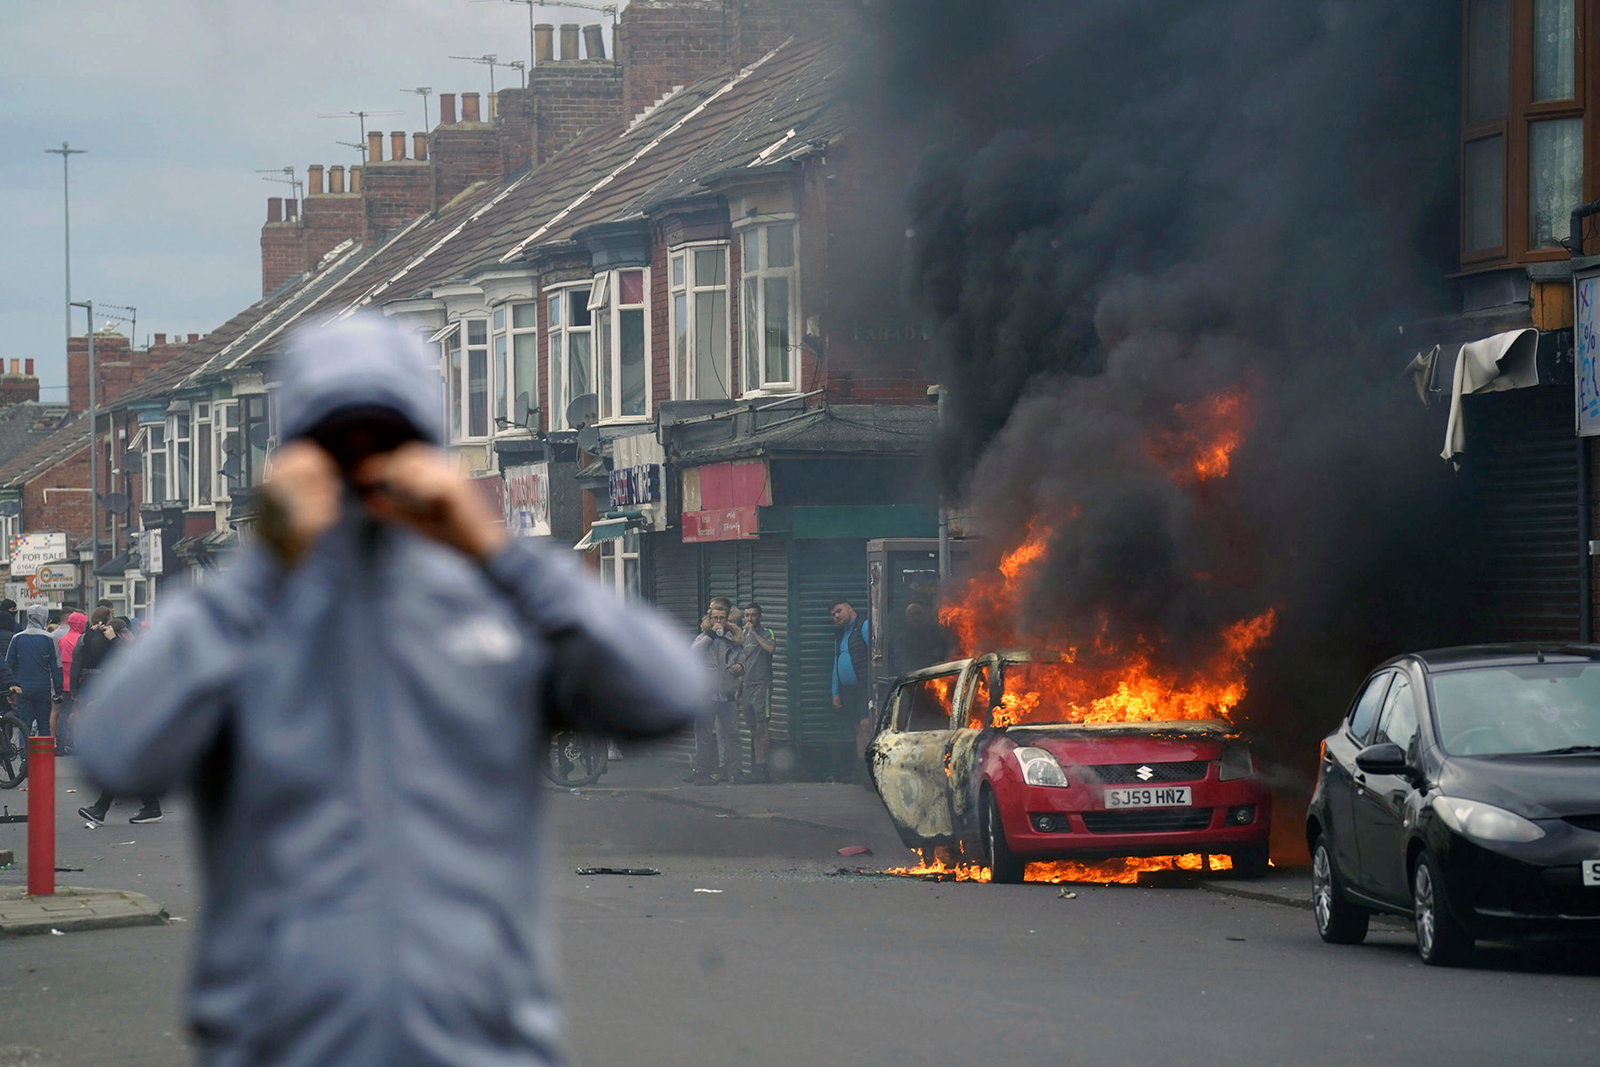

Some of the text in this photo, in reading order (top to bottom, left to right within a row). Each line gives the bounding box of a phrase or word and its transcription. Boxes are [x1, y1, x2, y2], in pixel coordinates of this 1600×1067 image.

[22, 552, 65, 562] FOR SALE
[1111, 789, 1186, 806] SJ59 HNZ
